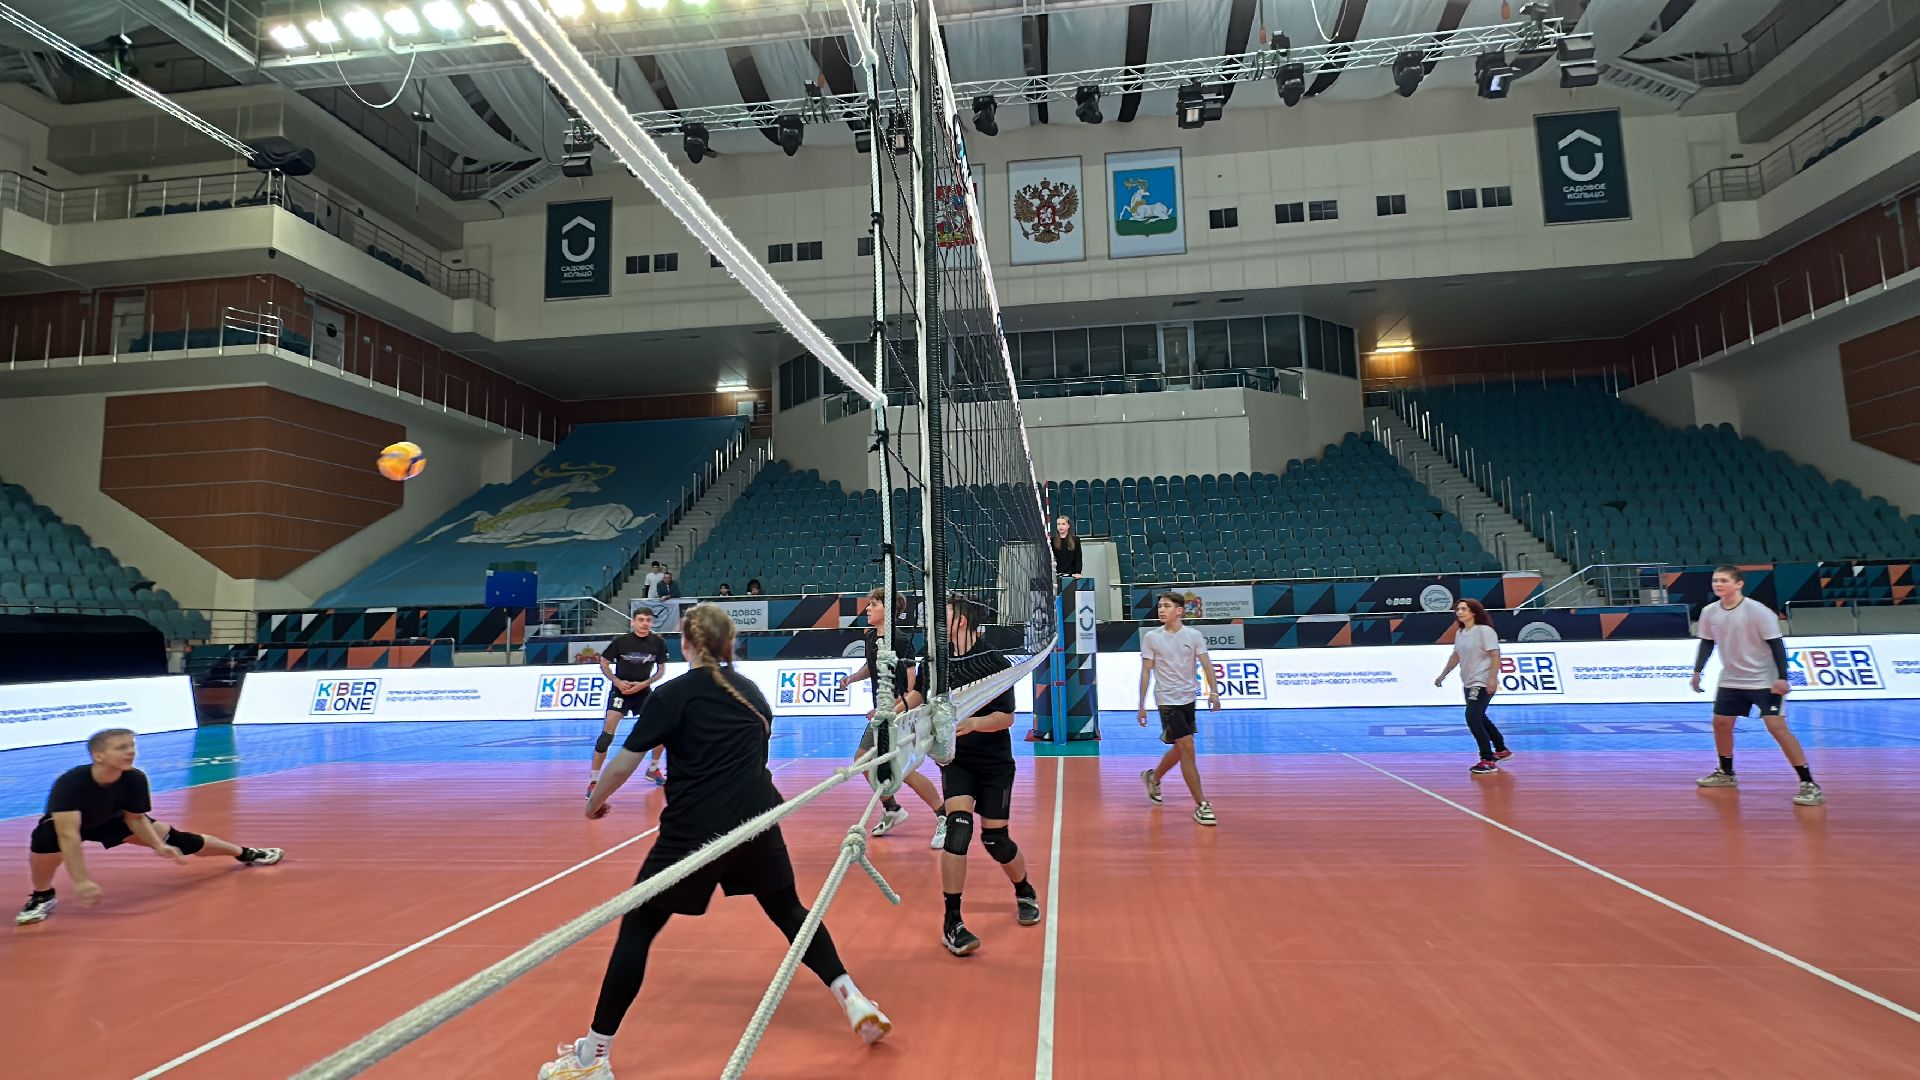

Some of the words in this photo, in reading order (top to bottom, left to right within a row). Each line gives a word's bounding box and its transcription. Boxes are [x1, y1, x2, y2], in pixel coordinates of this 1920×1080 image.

[1562, 183, 1606, 192] САДОВОЕ
[1567, 190, 1605, 199] КОЛЬЦО
[727, 608, 762, 616] АДОВОЕ
[1503, 674, 1557, 690] ONE
[1818, 668, 1878, 686] ONE
[560, 692, 601, 707] ONE
[802, 688, 846, 703] ONE
[333, 697, 372, 711] ONE
